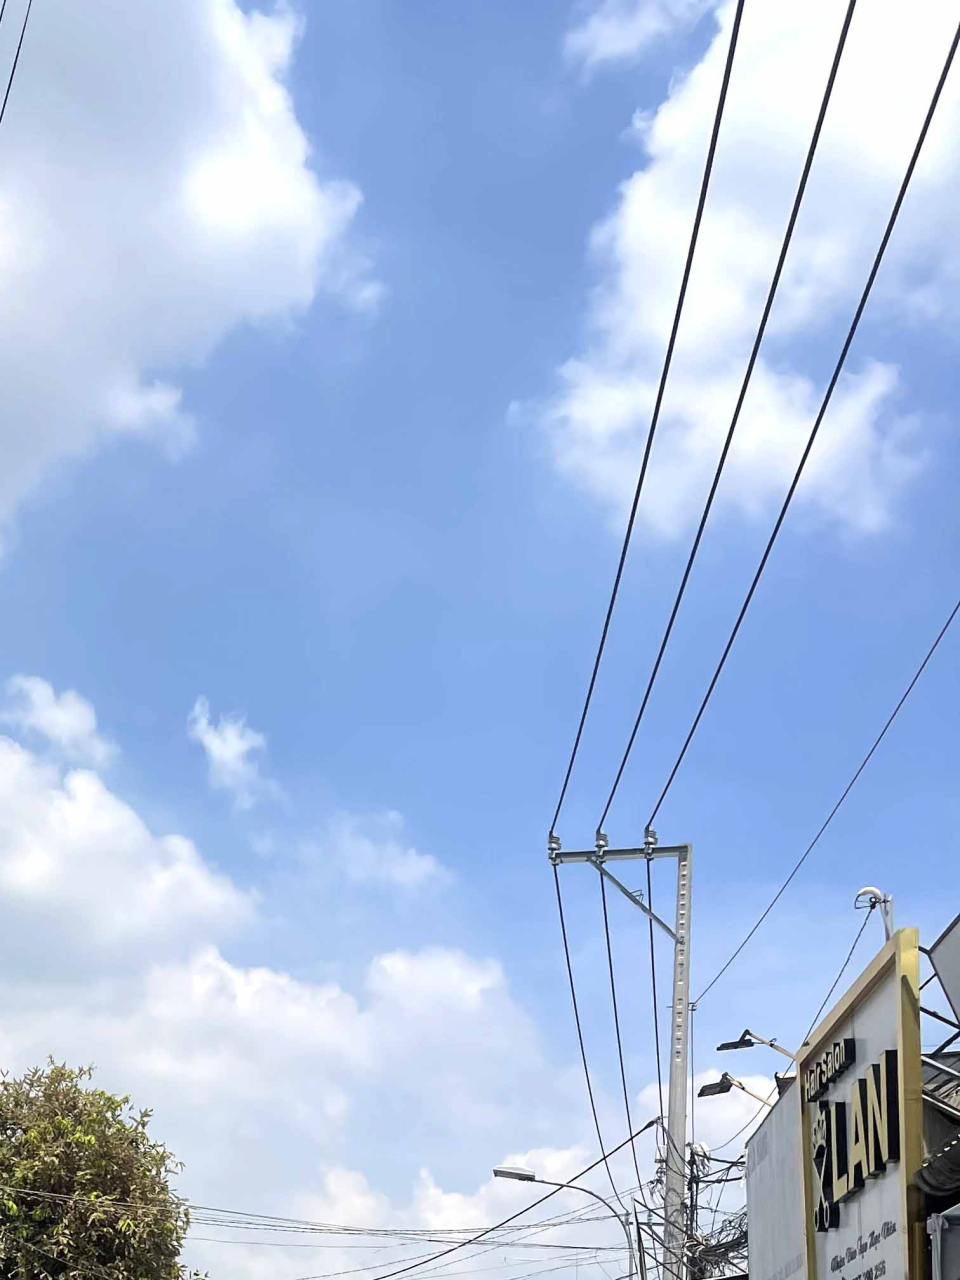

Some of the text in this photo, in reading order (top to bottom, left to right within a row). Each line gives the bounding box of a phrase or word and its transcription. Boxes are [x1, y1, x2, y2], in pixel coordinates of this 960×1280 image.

[804, 1039, 850, 1102] Hair Salon
[829, 1050, 897, 1203] LAN
